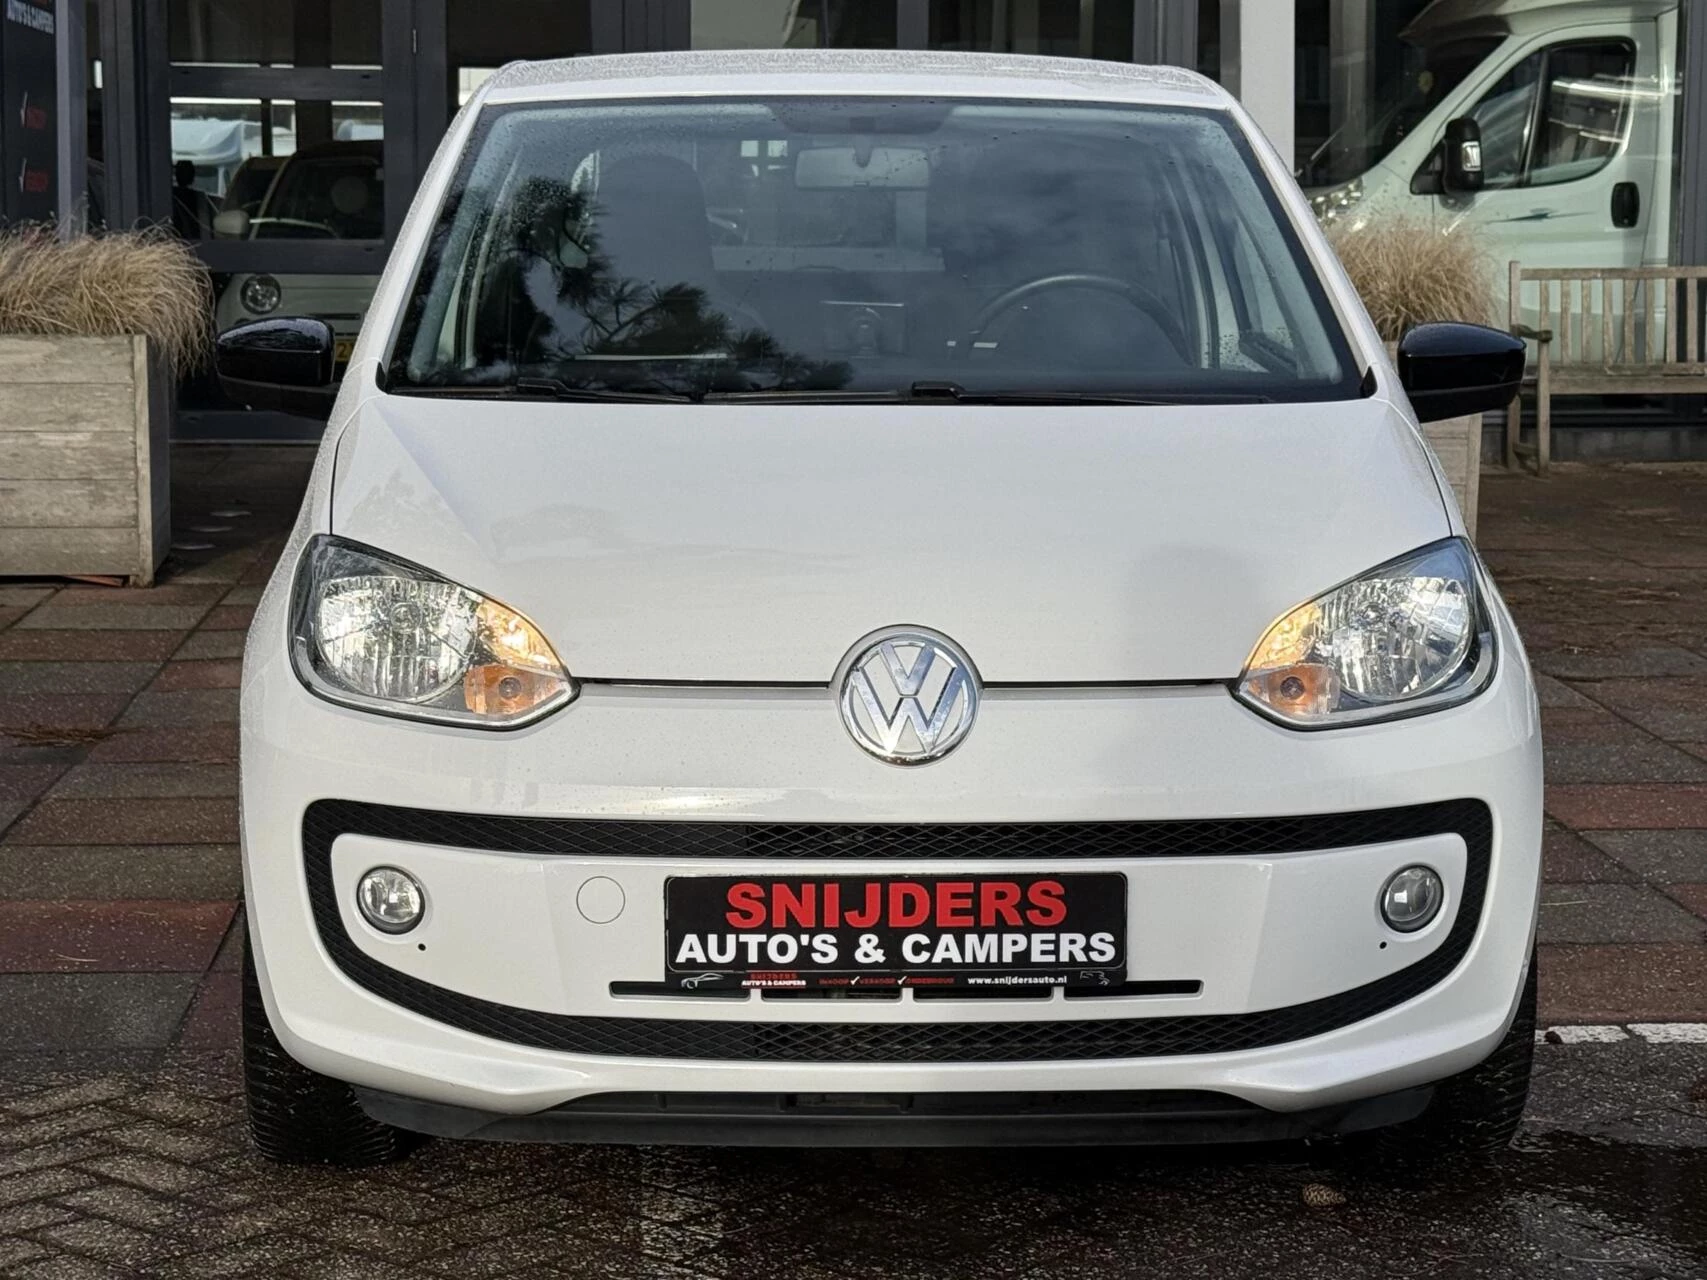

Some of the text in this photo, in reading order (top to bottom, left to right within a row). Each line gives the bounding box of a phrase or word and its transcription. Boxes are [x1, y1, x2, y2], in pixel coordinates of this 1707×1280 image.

[726, 881, 1067, 928] SNIJDERS
[675, 932, 1117, 964] AUTO'S & CAMPERS
[967, 976, 1067, 985] www.snijdersauto.nl
